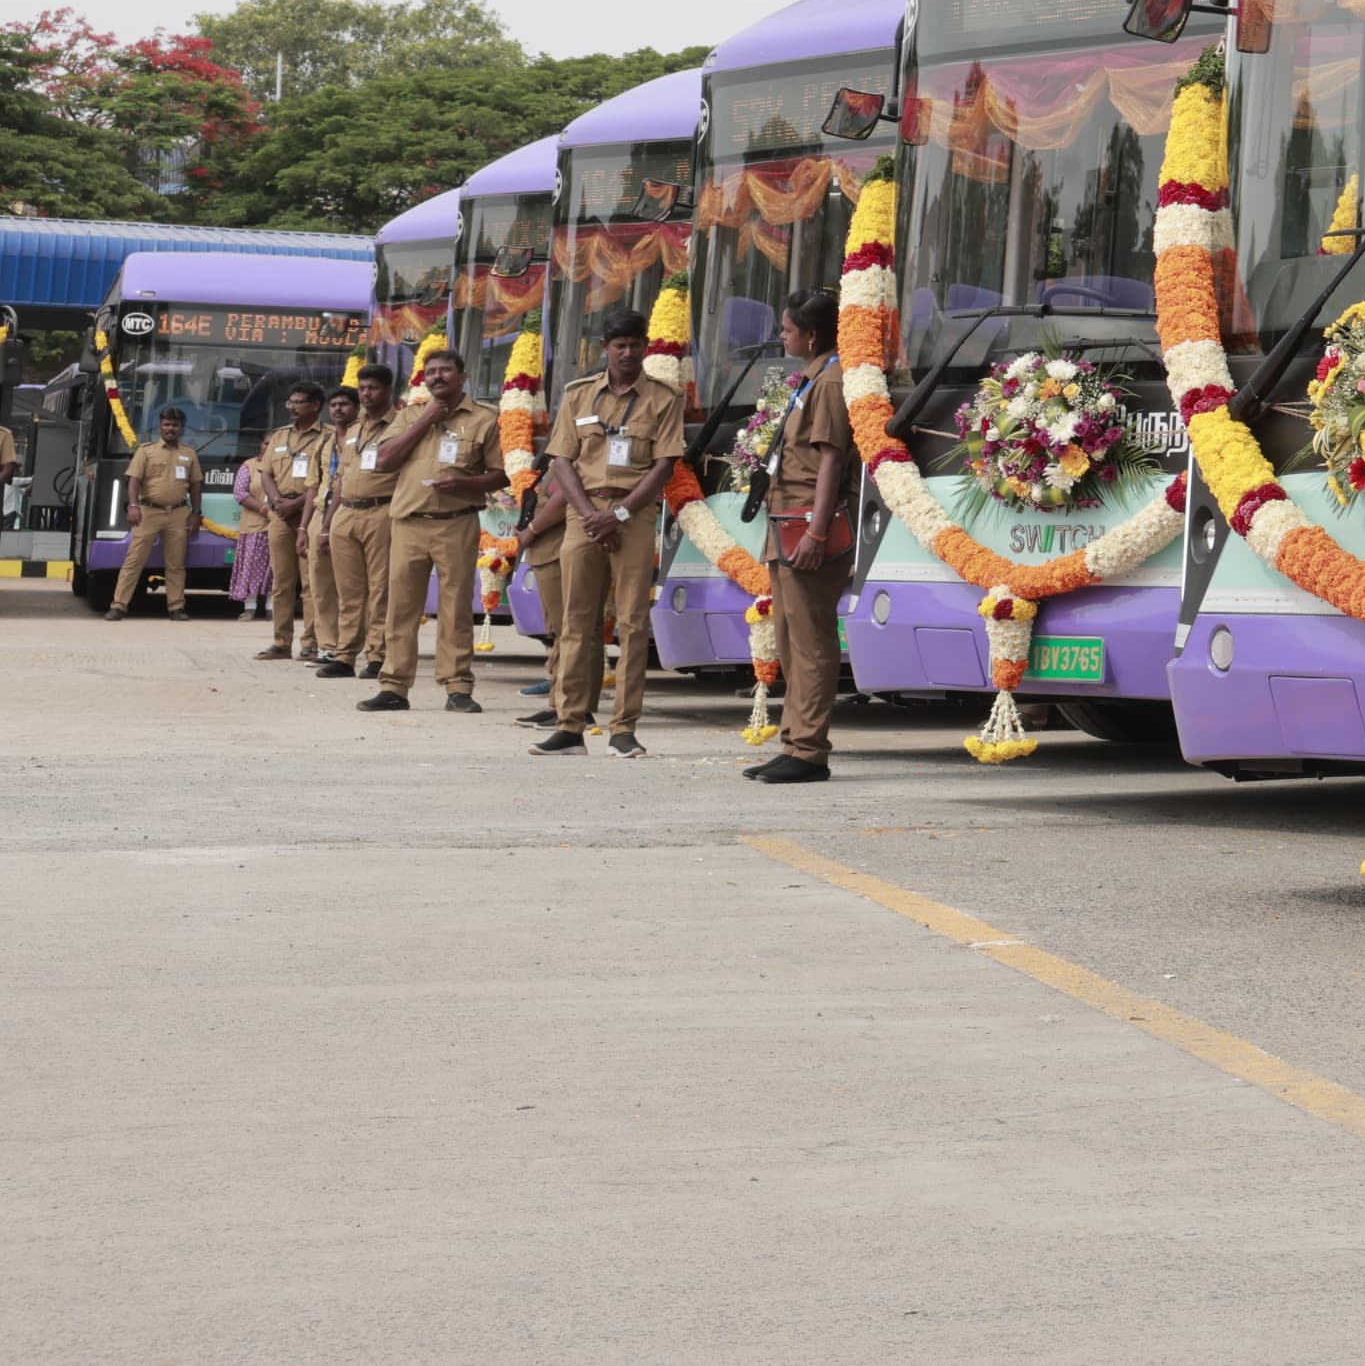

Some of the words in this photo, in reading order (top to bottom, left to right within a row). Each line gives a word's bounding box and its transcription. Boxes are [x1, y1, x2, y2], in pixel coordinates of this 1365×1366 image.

[124, 317, 152, 331] MTC
[158, 313, 214, 337] 164E
[227, 313, 321, 332] PERAMBU
[225, 327, 264, 343] VIA
[1033, 646, 1100, 672] 1BV3765
